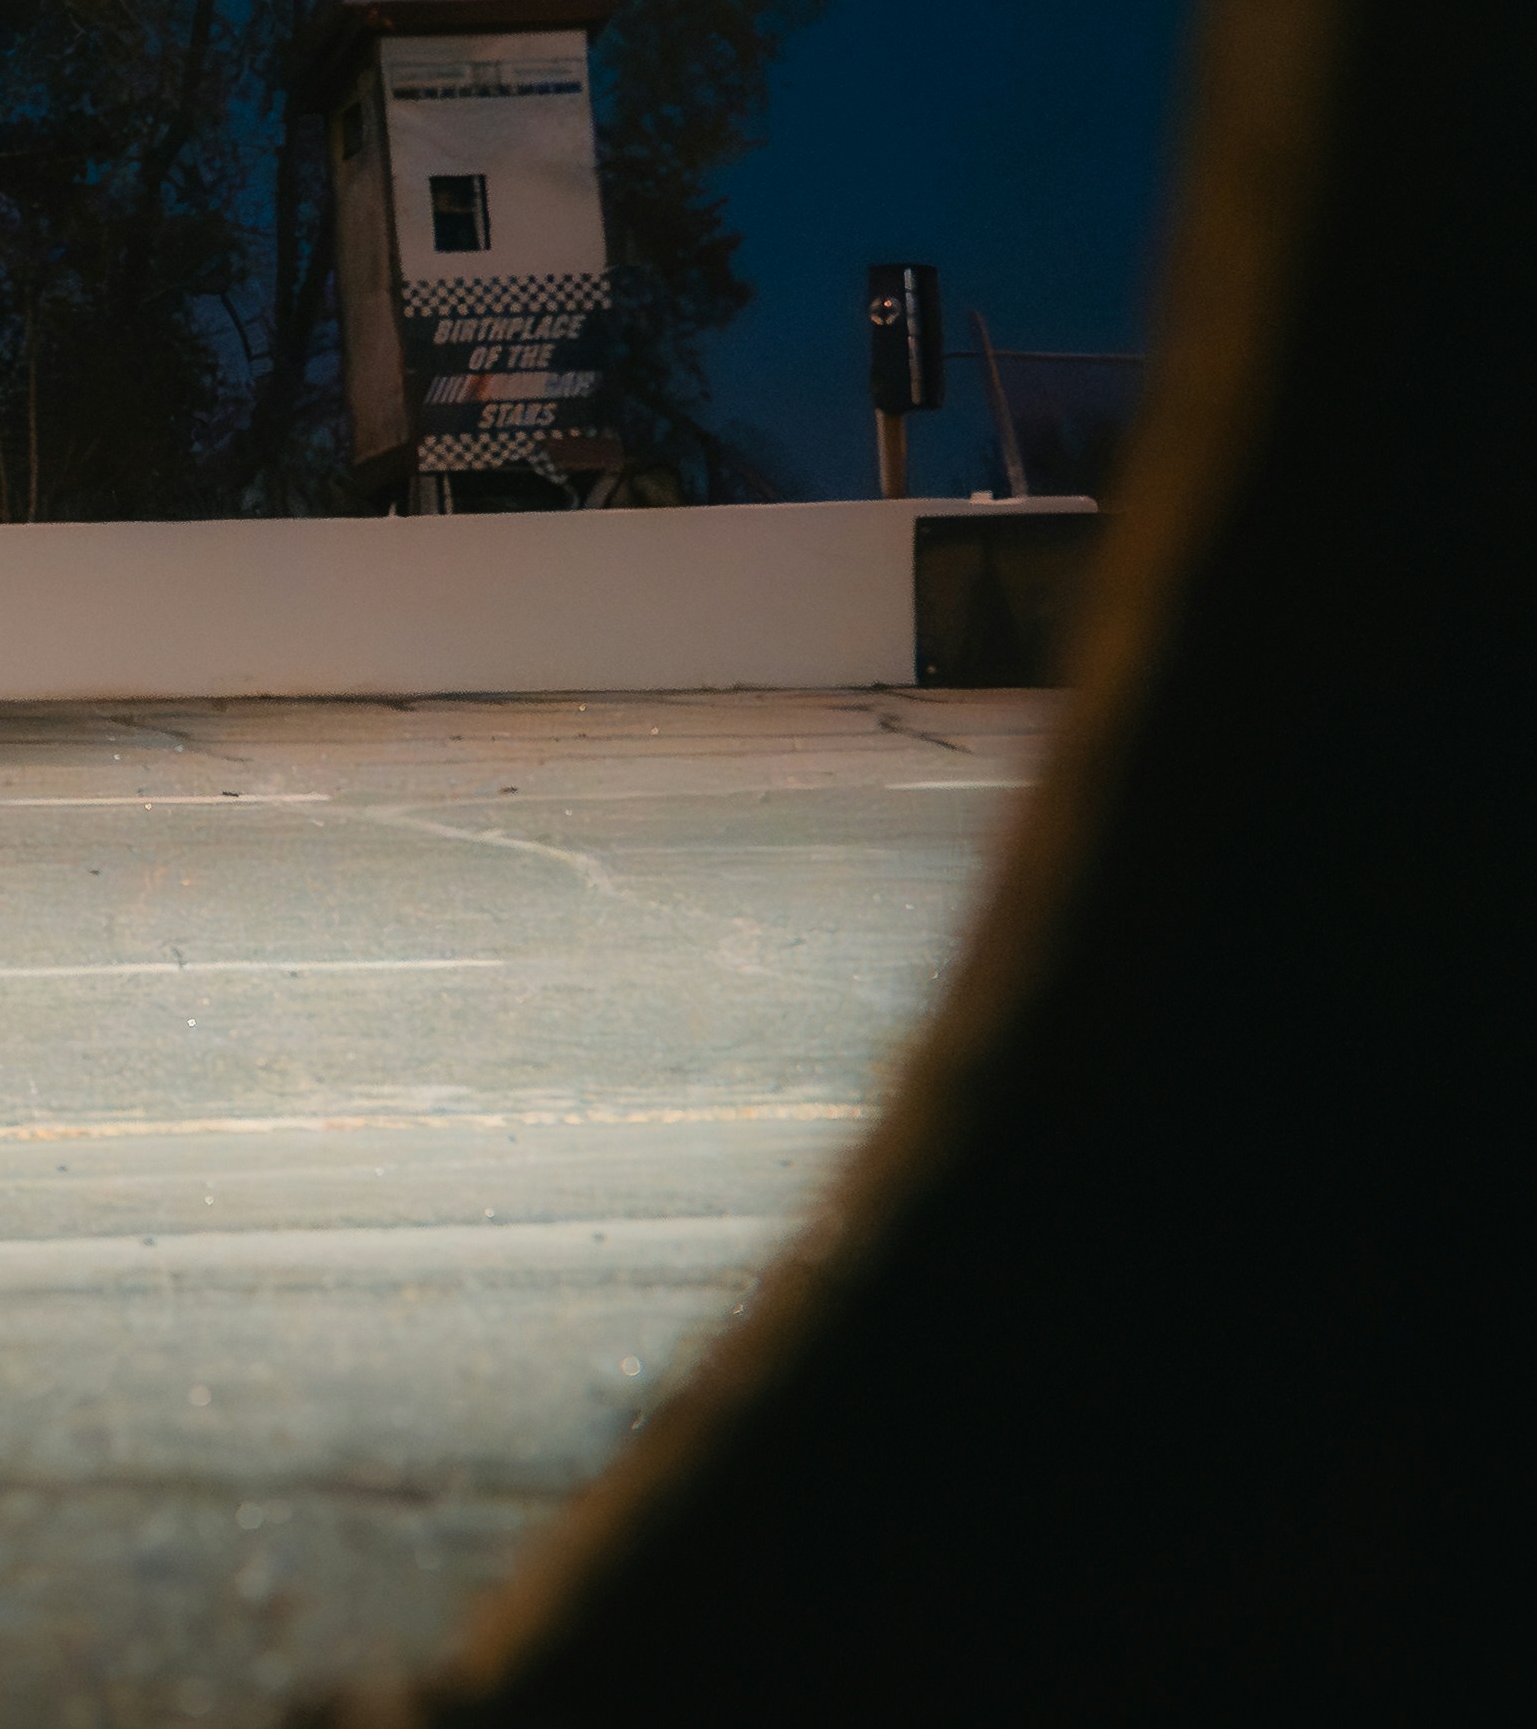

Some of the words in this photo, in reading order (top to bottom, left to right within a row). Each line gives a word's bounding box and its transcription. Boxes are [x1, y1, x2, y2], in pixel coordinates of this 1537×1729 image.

[433, 313, 587, 344] BIRTHPLACE
[468, 344, 502, 371] OF
[507, 343, 556, 368] THE
[477, 402, 558, 429] STARS
